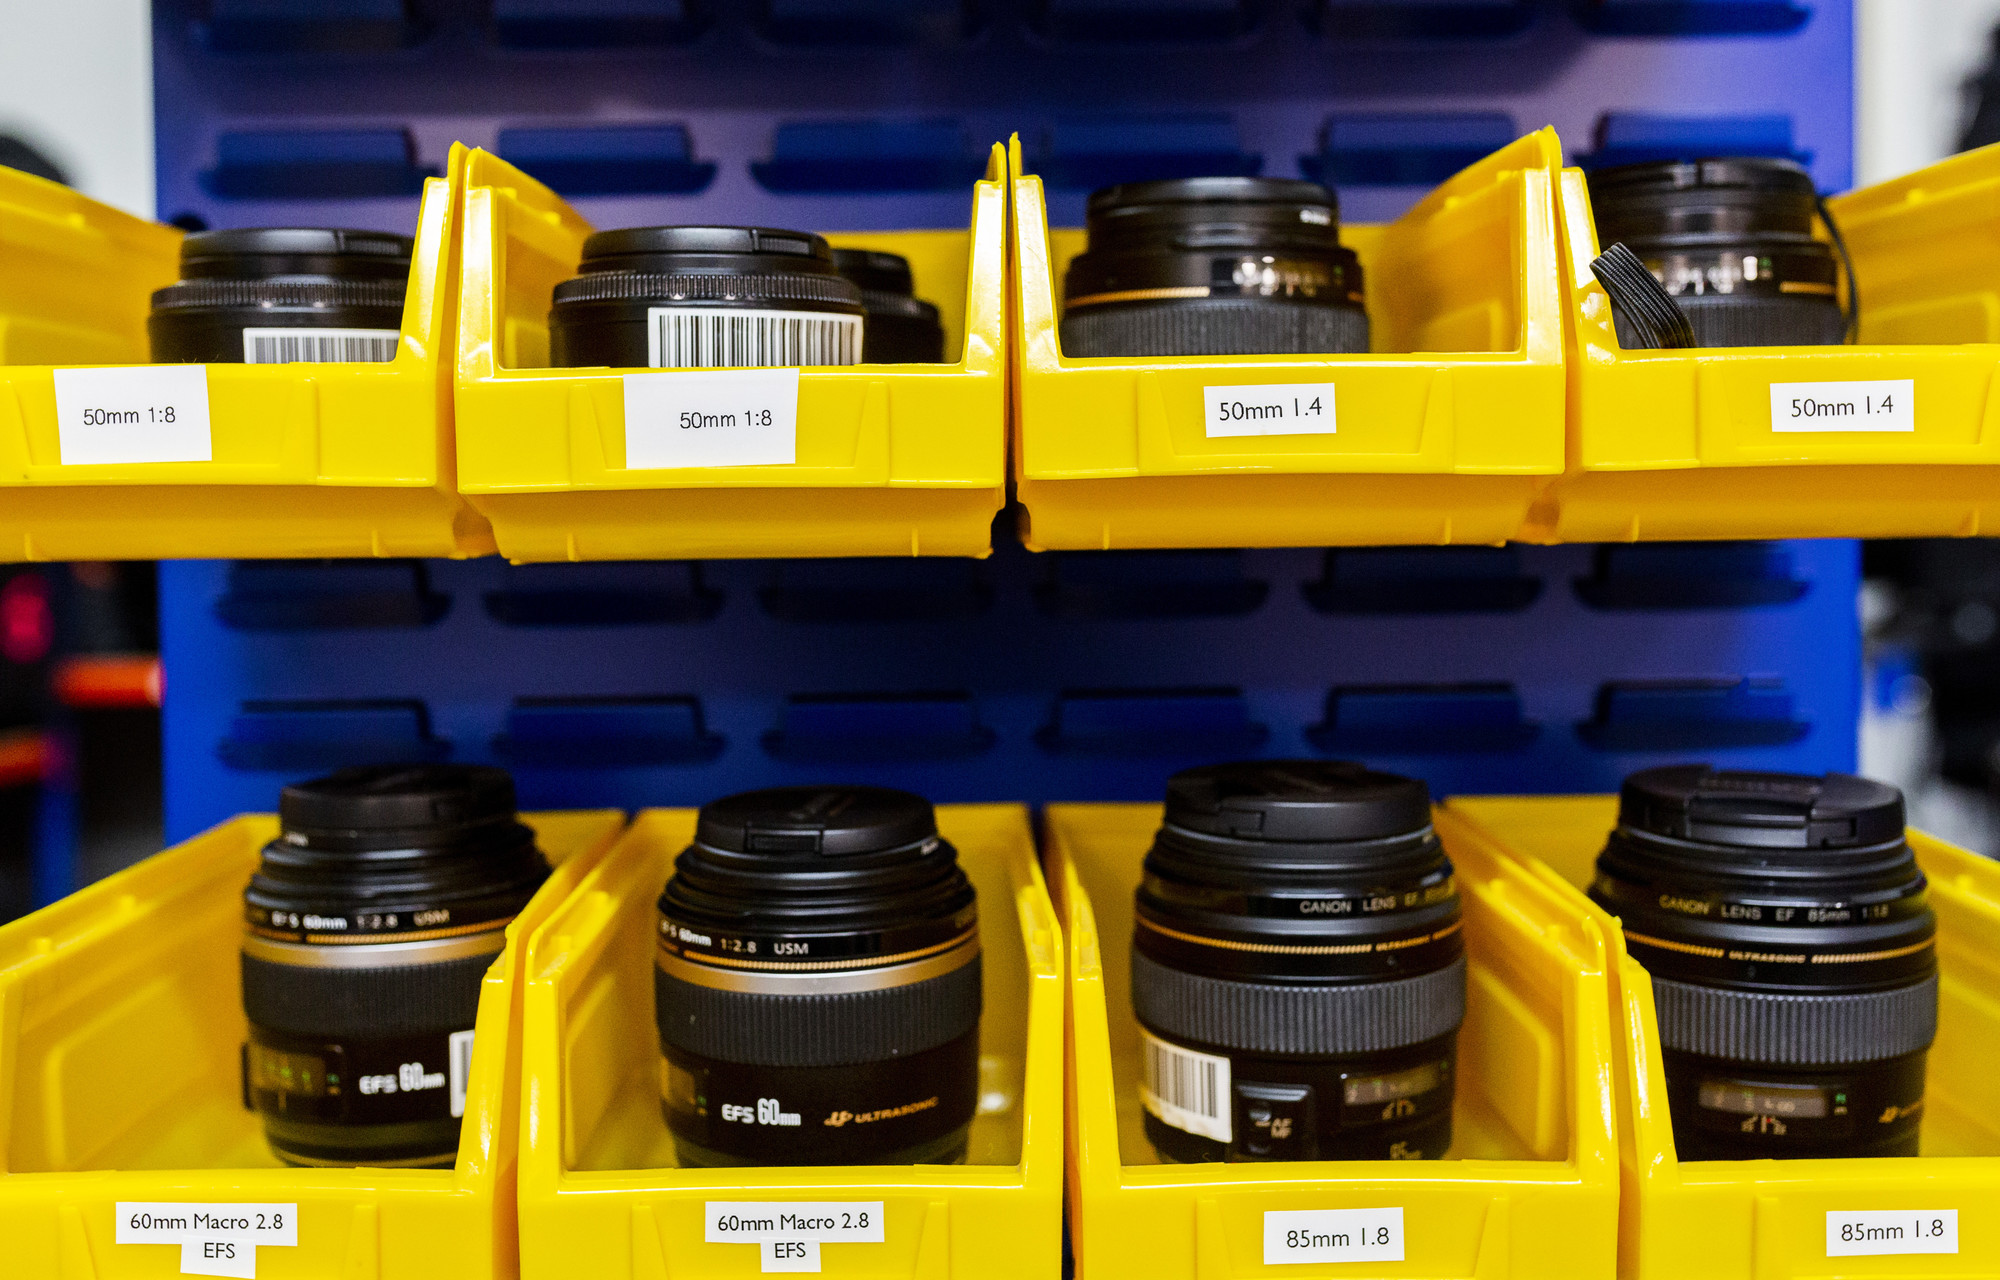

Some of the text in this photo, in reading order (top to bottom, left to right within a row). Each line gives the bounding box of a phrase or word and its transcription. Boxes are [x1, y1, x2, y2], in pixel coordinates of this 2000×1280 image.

[83, 406, 176, 426] 50mm 1:8
[1219, 396, 1323, 422] 50mm 1.4
[1791, 394, 1894, 418] 50mm 1.4
[679, 409, 773, 430] 50mm 1:8
[1299, 900, 1352, 914] CANON
[1362, 896, 1396, 911] LENS
[1659, 894, 1710, 915] CANON
[1720, 904, 1762, 920] LENS
[1775, 908, 1796, 922] EF
[720, 938, 757, 954] 1:2.8
[773, 943, 809, 955] USM
[721, 1098, 801, 1126] EFS 60mm
[855, 1096, 939, 1124] ULTRASONIC
[130, 1213, 284, 1230] 60mm Macro 2.8
[717, 1212, 870, 1232] 60mm Macro 2.8
[1841, 1219, 1944, 1242] 85mm 1.8
[1286, 1226, 1390, 1249] 85mm 1.8
[203, 1242, 236, 1259] EFS
[774, 1241, 806, 1259] EFS
